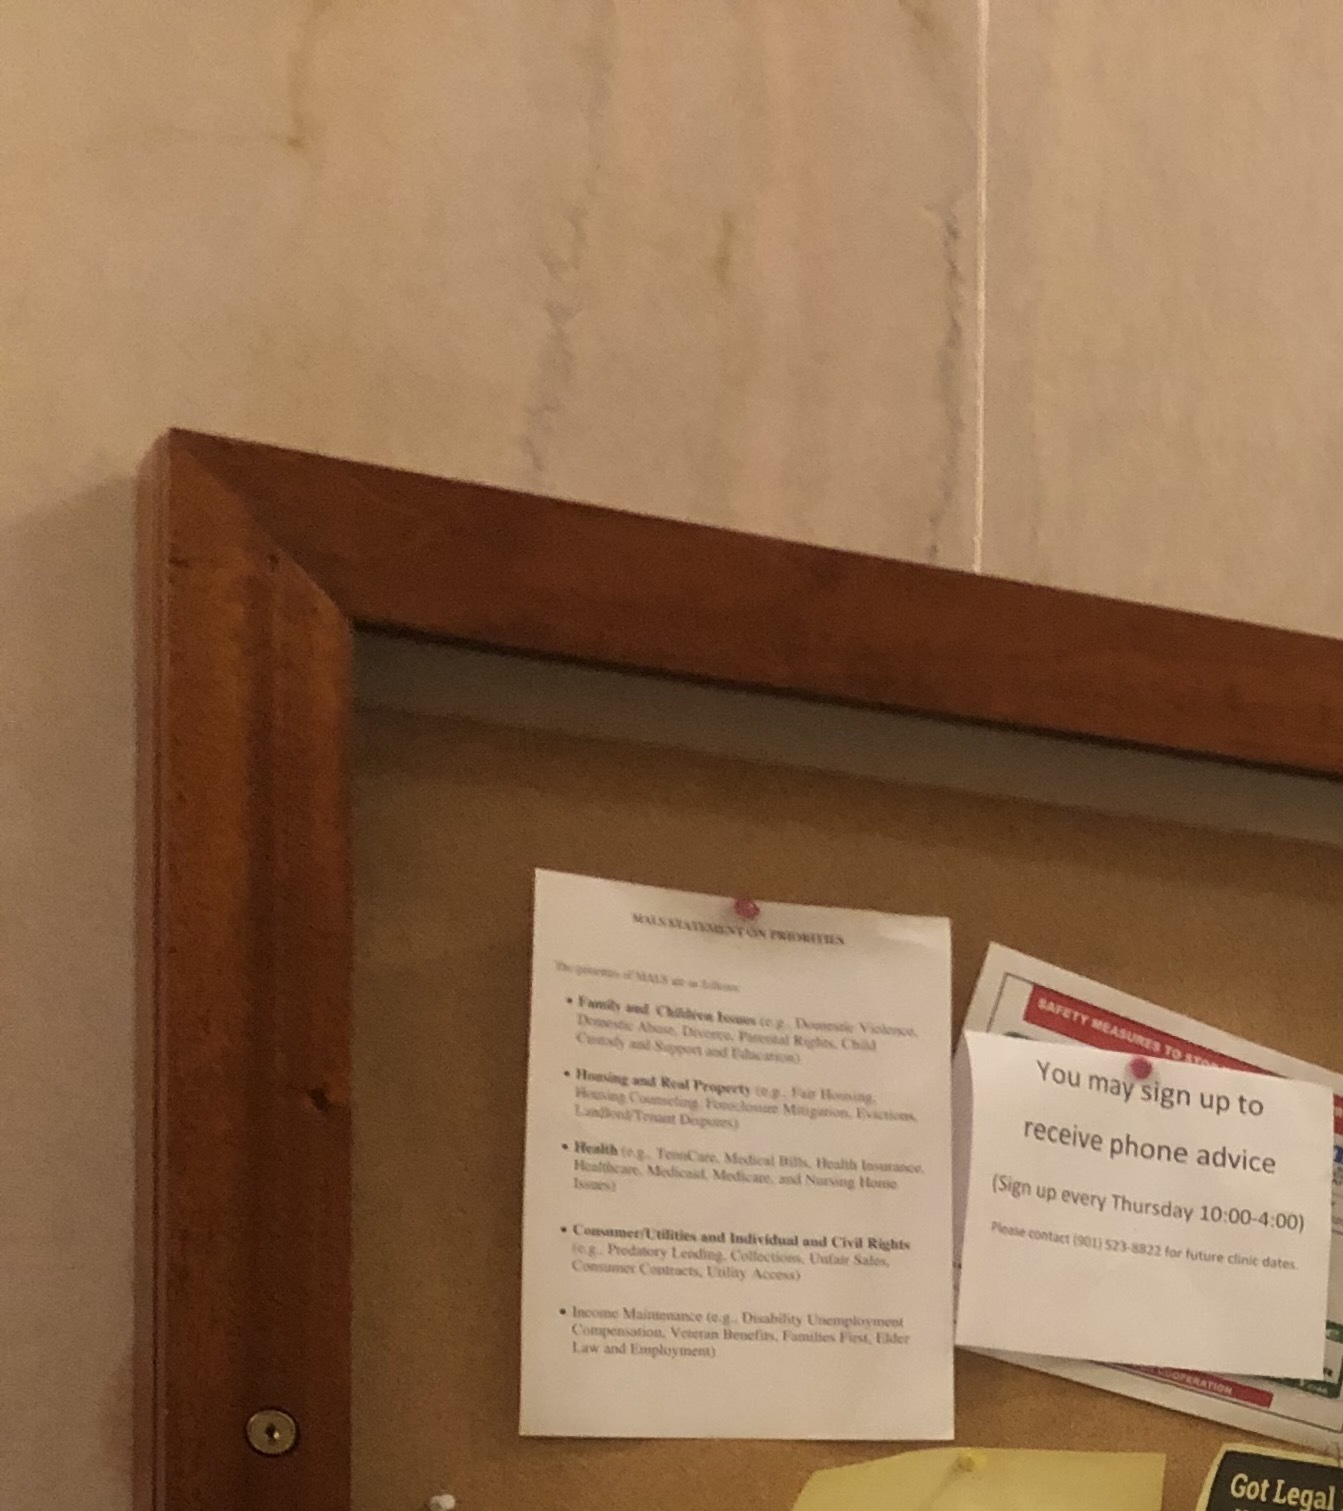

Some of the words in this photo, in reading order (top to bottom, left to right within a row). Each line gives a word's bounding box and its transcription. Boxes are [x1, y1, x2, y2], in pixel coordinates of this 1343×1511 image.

[1037, 998, 1089, 1024] SAFETY
[1091, 1017, 1162, 1053] MEASURES
[1165, 1043, 1183, 1060] TO
[1036, 1059, 1080, 1088] You
[1087, 1073, 1137, 1102] may
[1136, 1075, 1190, 1111] sign
[1199, 1091, 1229, 1117] up
[1237, 1090, 1264, 1116] to
[1023, 1117, 1102, 1149] receive
[1110, 1129, 1187, 1167] phone
[1196, 1141, 1276, 1173] advice
[991, 1173, 1031, 1202] (Sign
[1036, 1184, 1056, 1205] up
[1061, 1187, 1106, 1212] every
[1112, 1189, 1193, 1222] Thursday
[1201, 1200, 1304, 1237] 10:00-4:00)
[1230, 1473, 1270, 1502] Got
